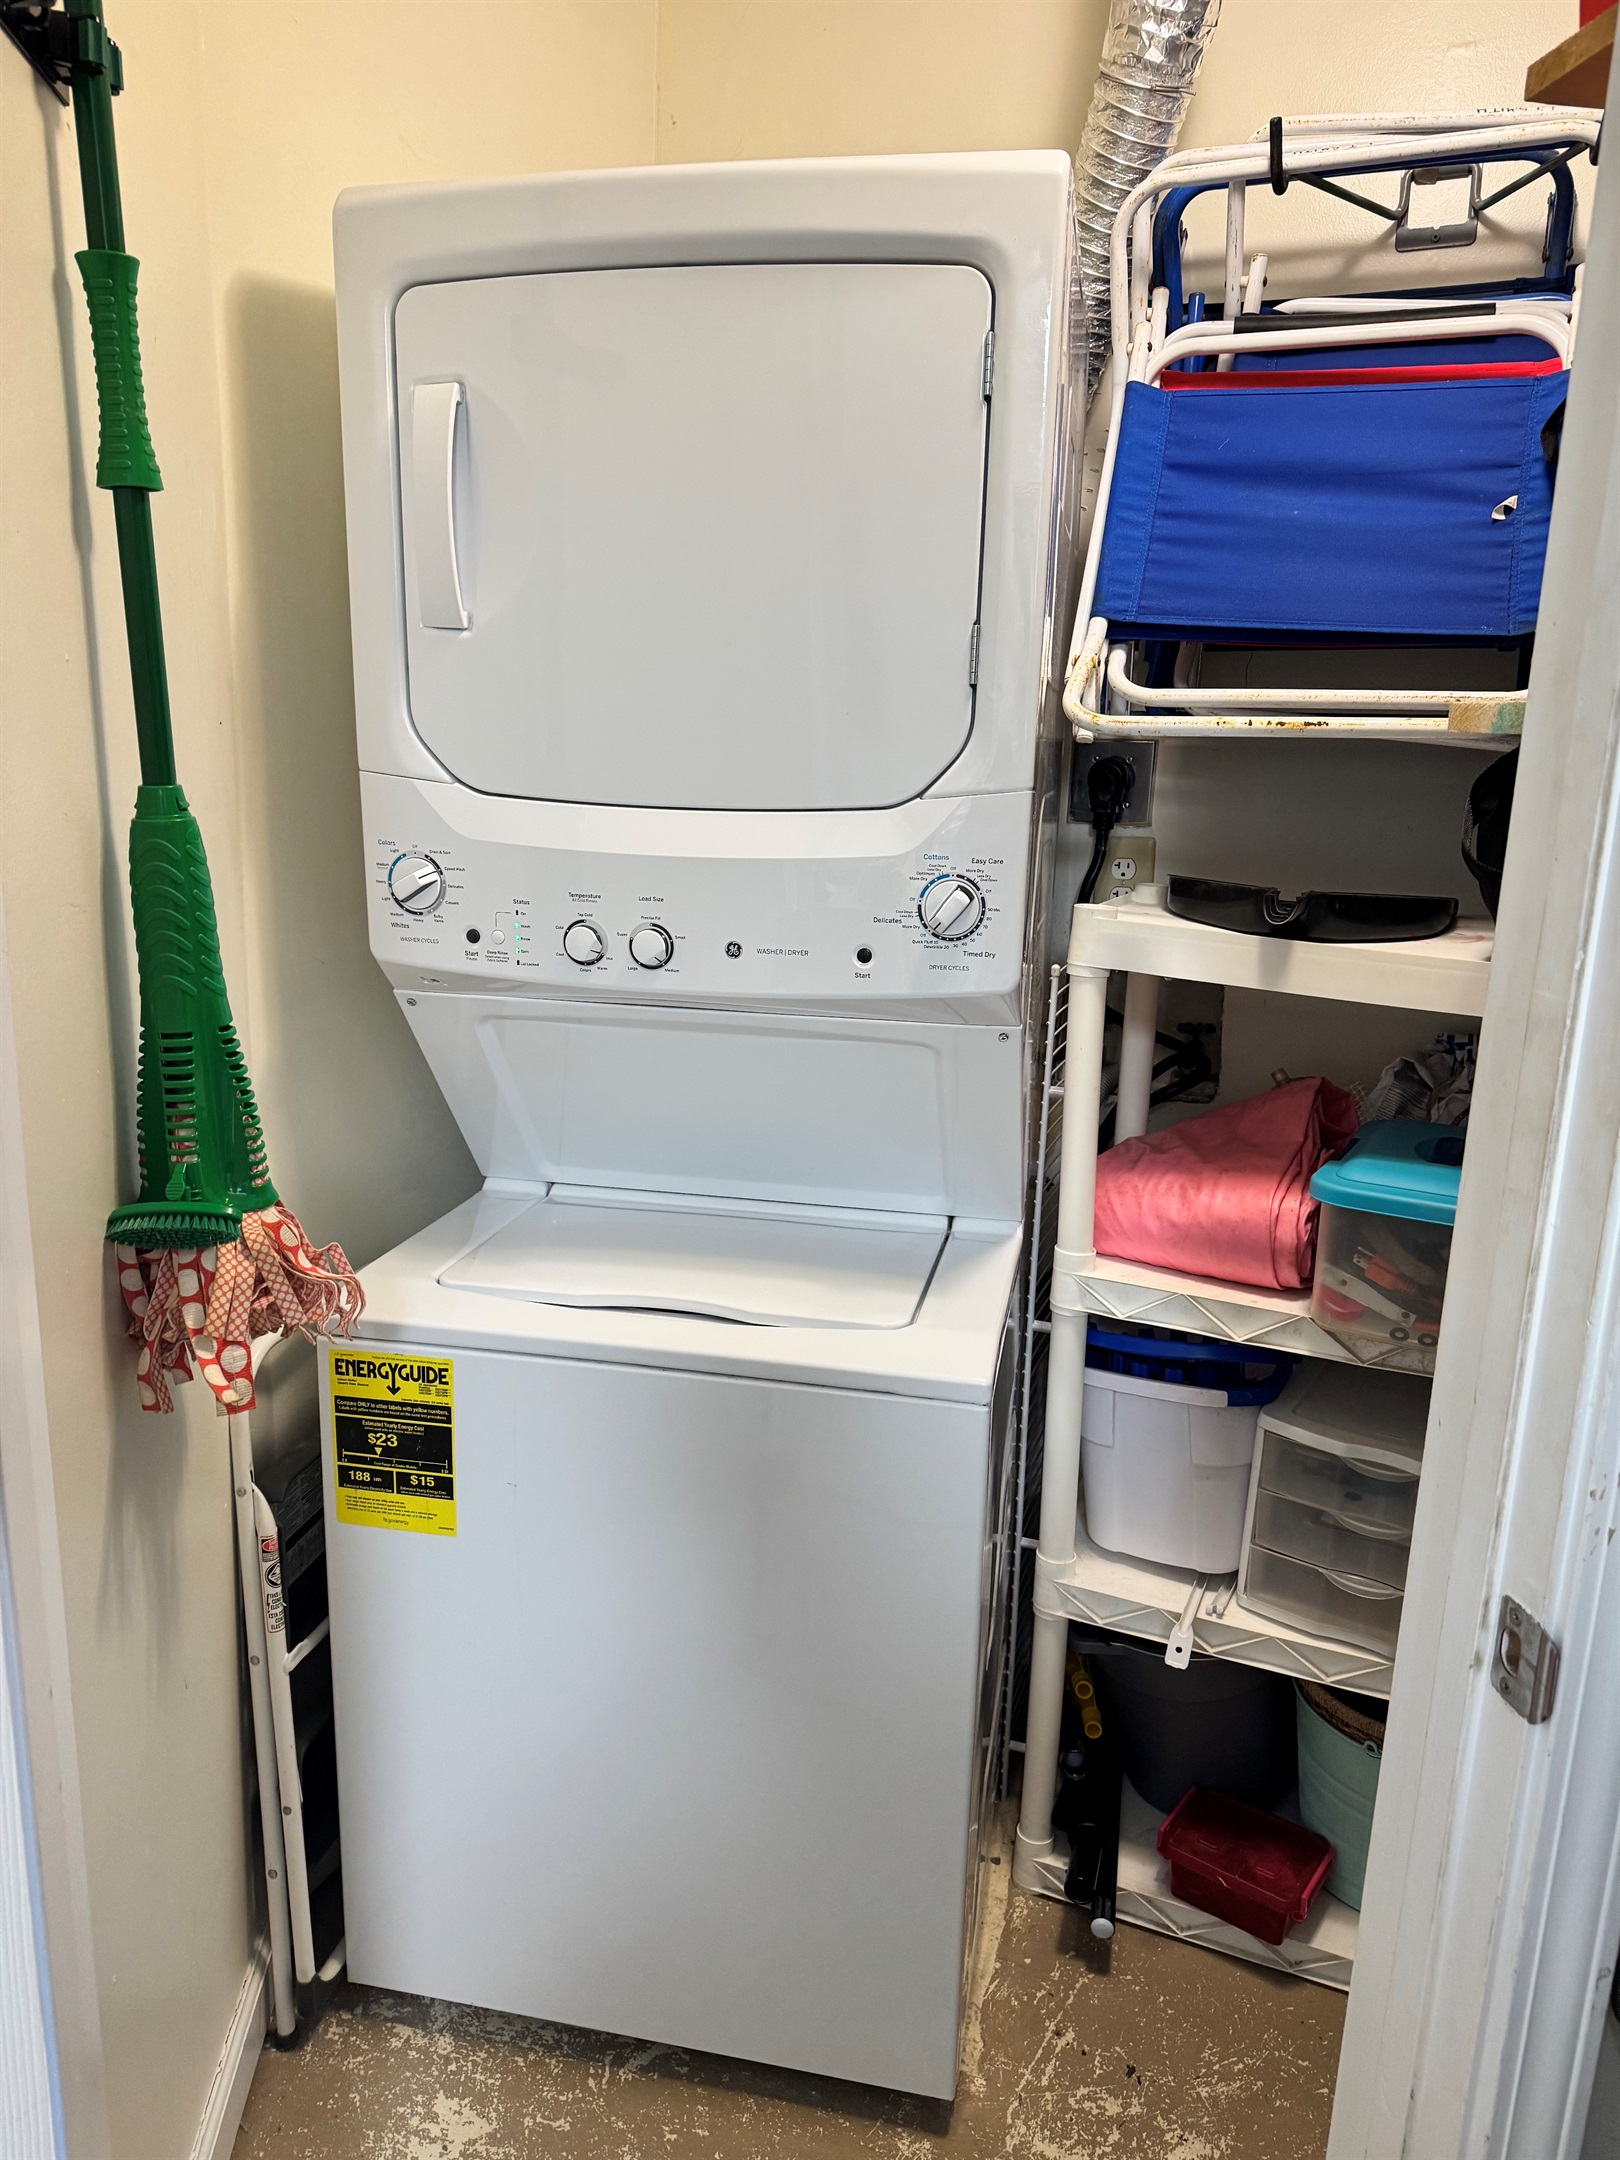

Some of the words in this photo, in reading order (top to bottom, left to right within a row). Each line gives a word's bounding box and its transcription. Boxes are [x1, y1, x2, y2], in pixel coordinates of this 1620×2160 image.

[335, 1358, 449, 1386] ENERGYGUIDE
[368, 1432, 398, 1447] $23
[349, 1471, 370, 1481] 188
[410, 1475, 435, 1486] $15
